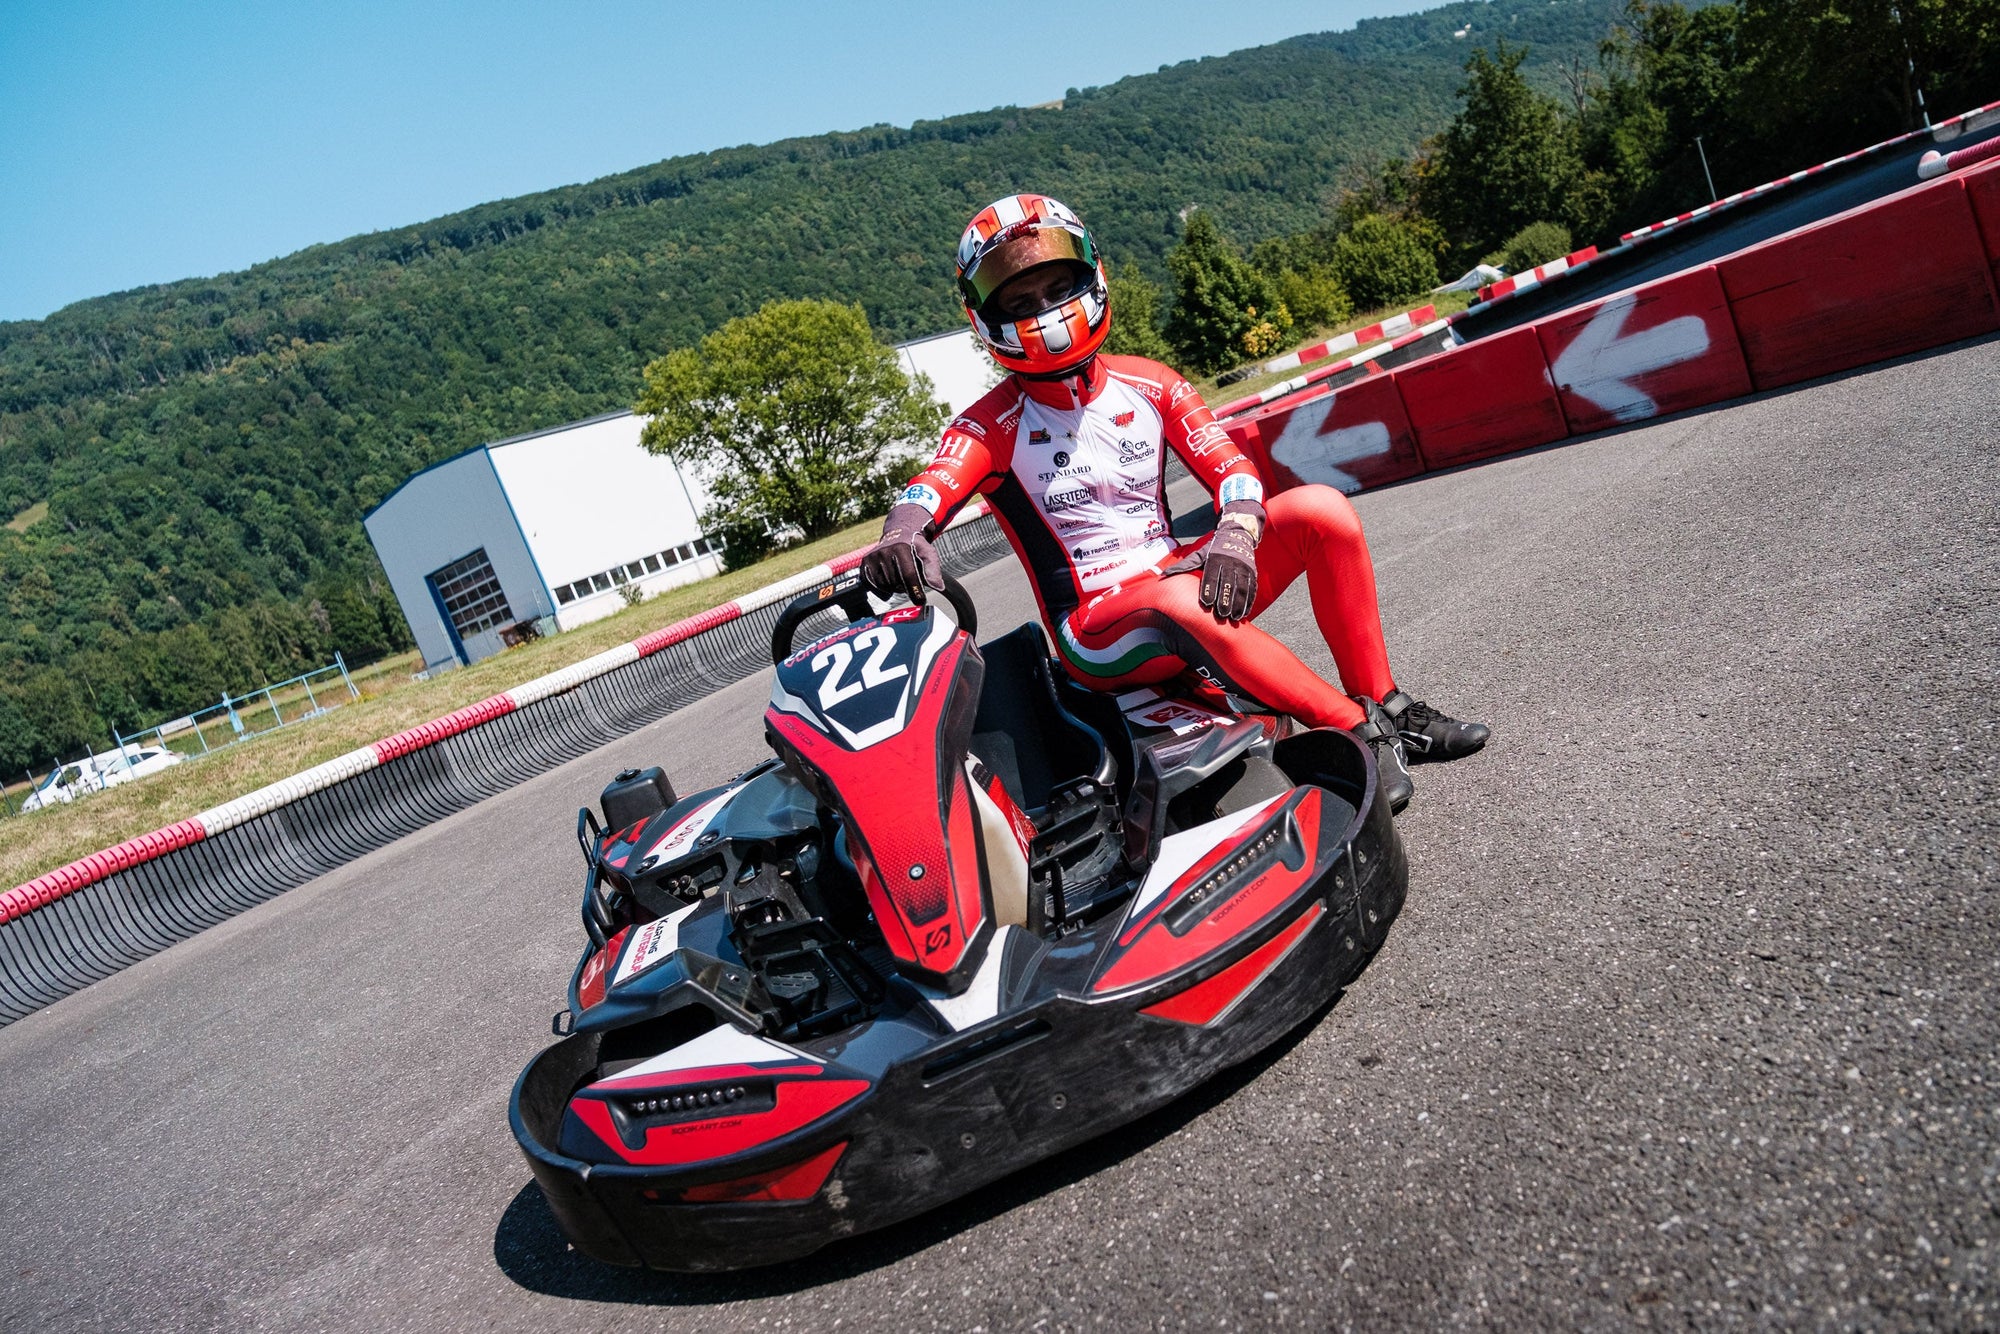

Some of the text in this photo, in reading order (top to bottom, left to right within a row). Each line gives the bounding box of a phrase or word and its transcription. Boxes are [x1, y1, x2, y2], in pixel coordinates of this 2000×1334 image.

[1137, 384, 1162, 402] CELER
[1135, 440, 1150, 451] CPL
[1038, 465, 1092, 481] STANDARD
[1042, 487, 1092, 507] LASERTECH
[1222, 583, 1232, 607] CELER
[811, 626, 909, 711] 22
[1210, 876, 1268, 924] SODIKART.COM
[648, 917, 669, 955] KARTING
[670, 1119, 743, 1136] SODIKART.COM
